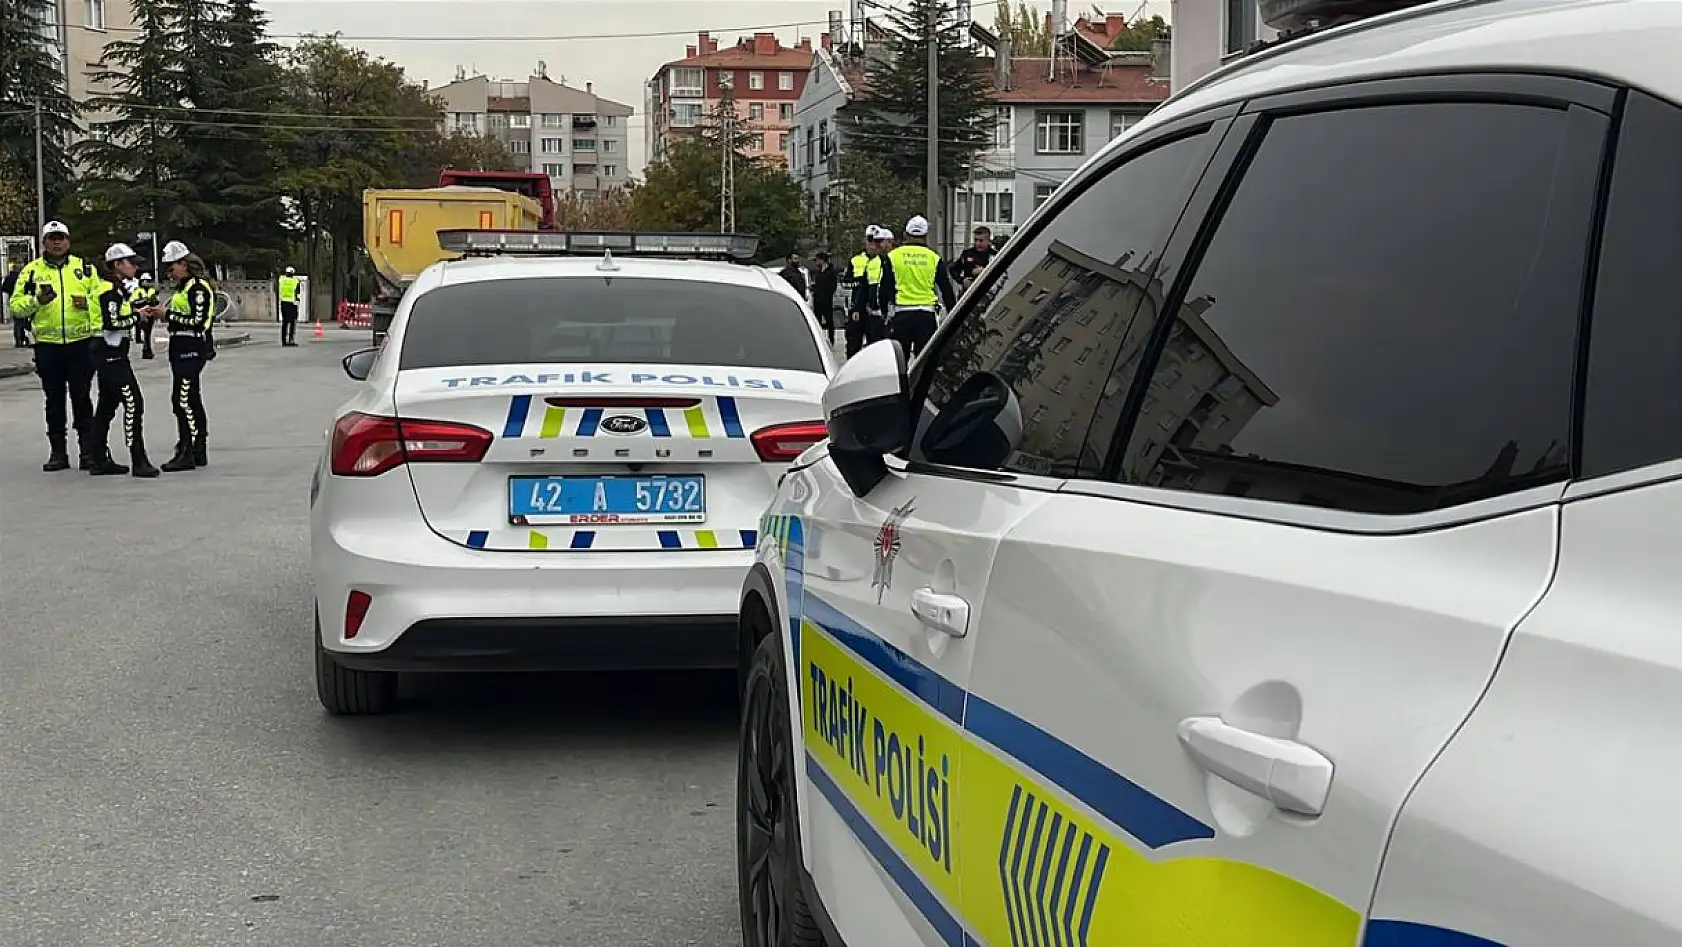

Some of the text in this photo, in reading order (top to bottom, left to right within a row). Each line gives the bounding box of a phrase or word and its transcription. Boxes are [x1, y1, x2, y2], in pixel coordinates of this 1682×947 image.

[610, 417, 638, 431] Ford
[529, 480, 700, 512] 42 A 5732
[810, 660, 951, 875] TRAFİK POLİSİ
